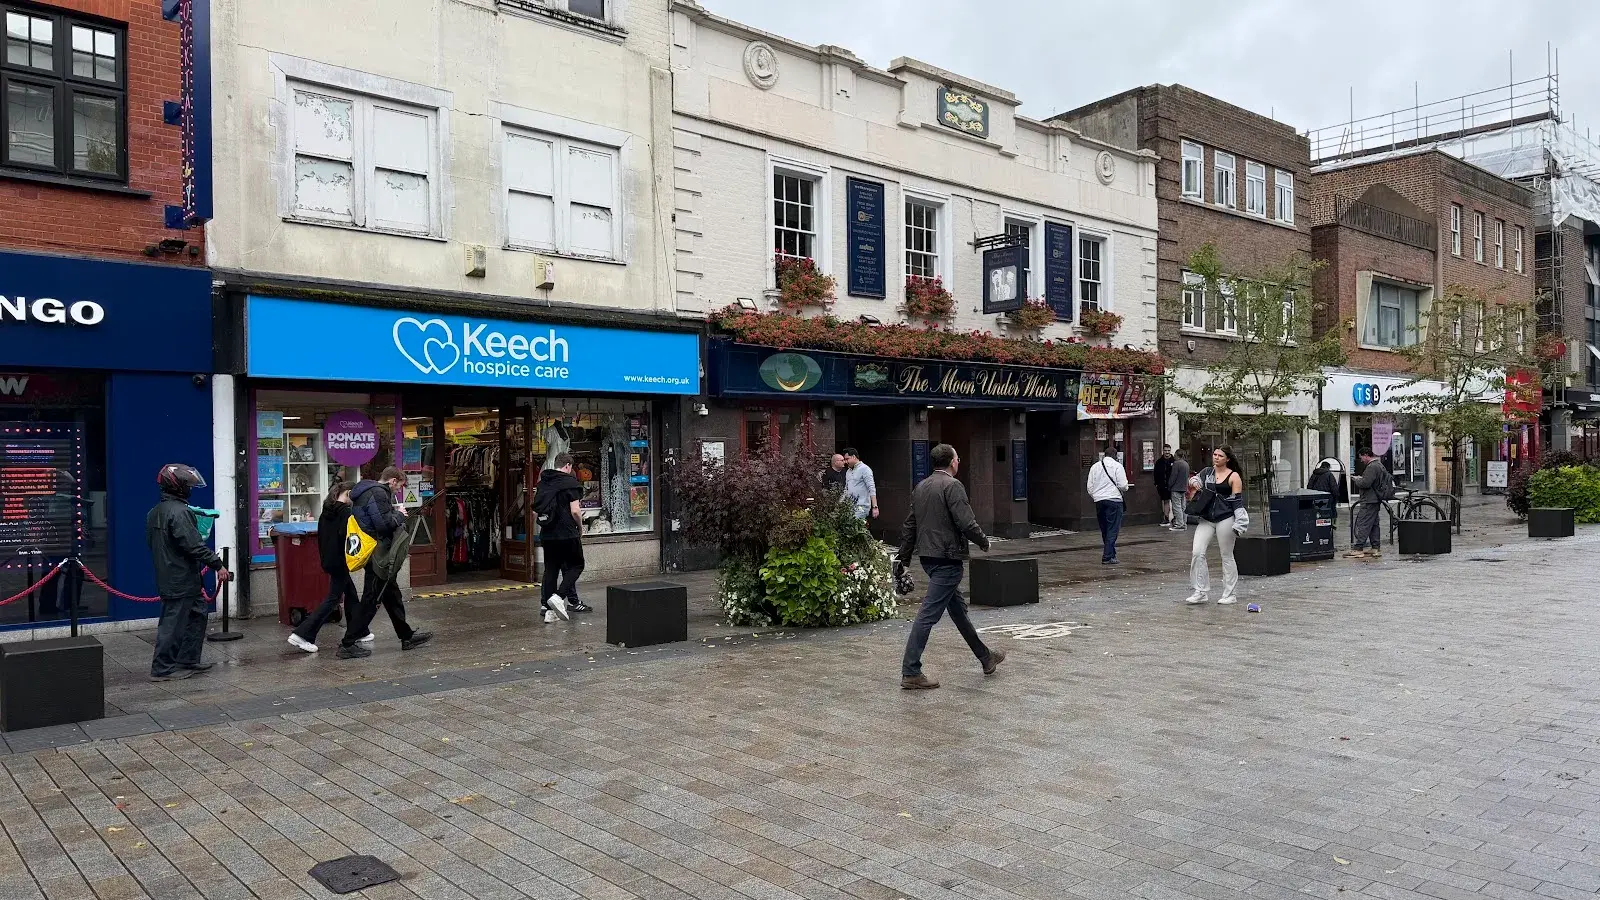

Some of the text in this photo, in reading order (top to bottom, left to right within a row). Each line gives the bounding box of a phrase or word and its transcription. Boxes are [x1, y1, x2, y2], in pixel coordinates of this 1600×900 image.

[0, 294, 105, 325] NGO
[463, 322, 569, 362] Keech
[463, 357, 569, 379] hospice care
[623, 374, 690, 385] www.keech.org.uk
[896, 365, 929, 394] The
[930, 366, 976, 395] Moon
[976, 369, 1020, 397] Under
[1020, 370, 1058, 399] Water
[1081, 384, 1119, 406] BEER
[1356, 386, 1379, 402] TSB
[327, 432, 375, 442] DONATE
[328, 441, 375, 450] Feel Great
